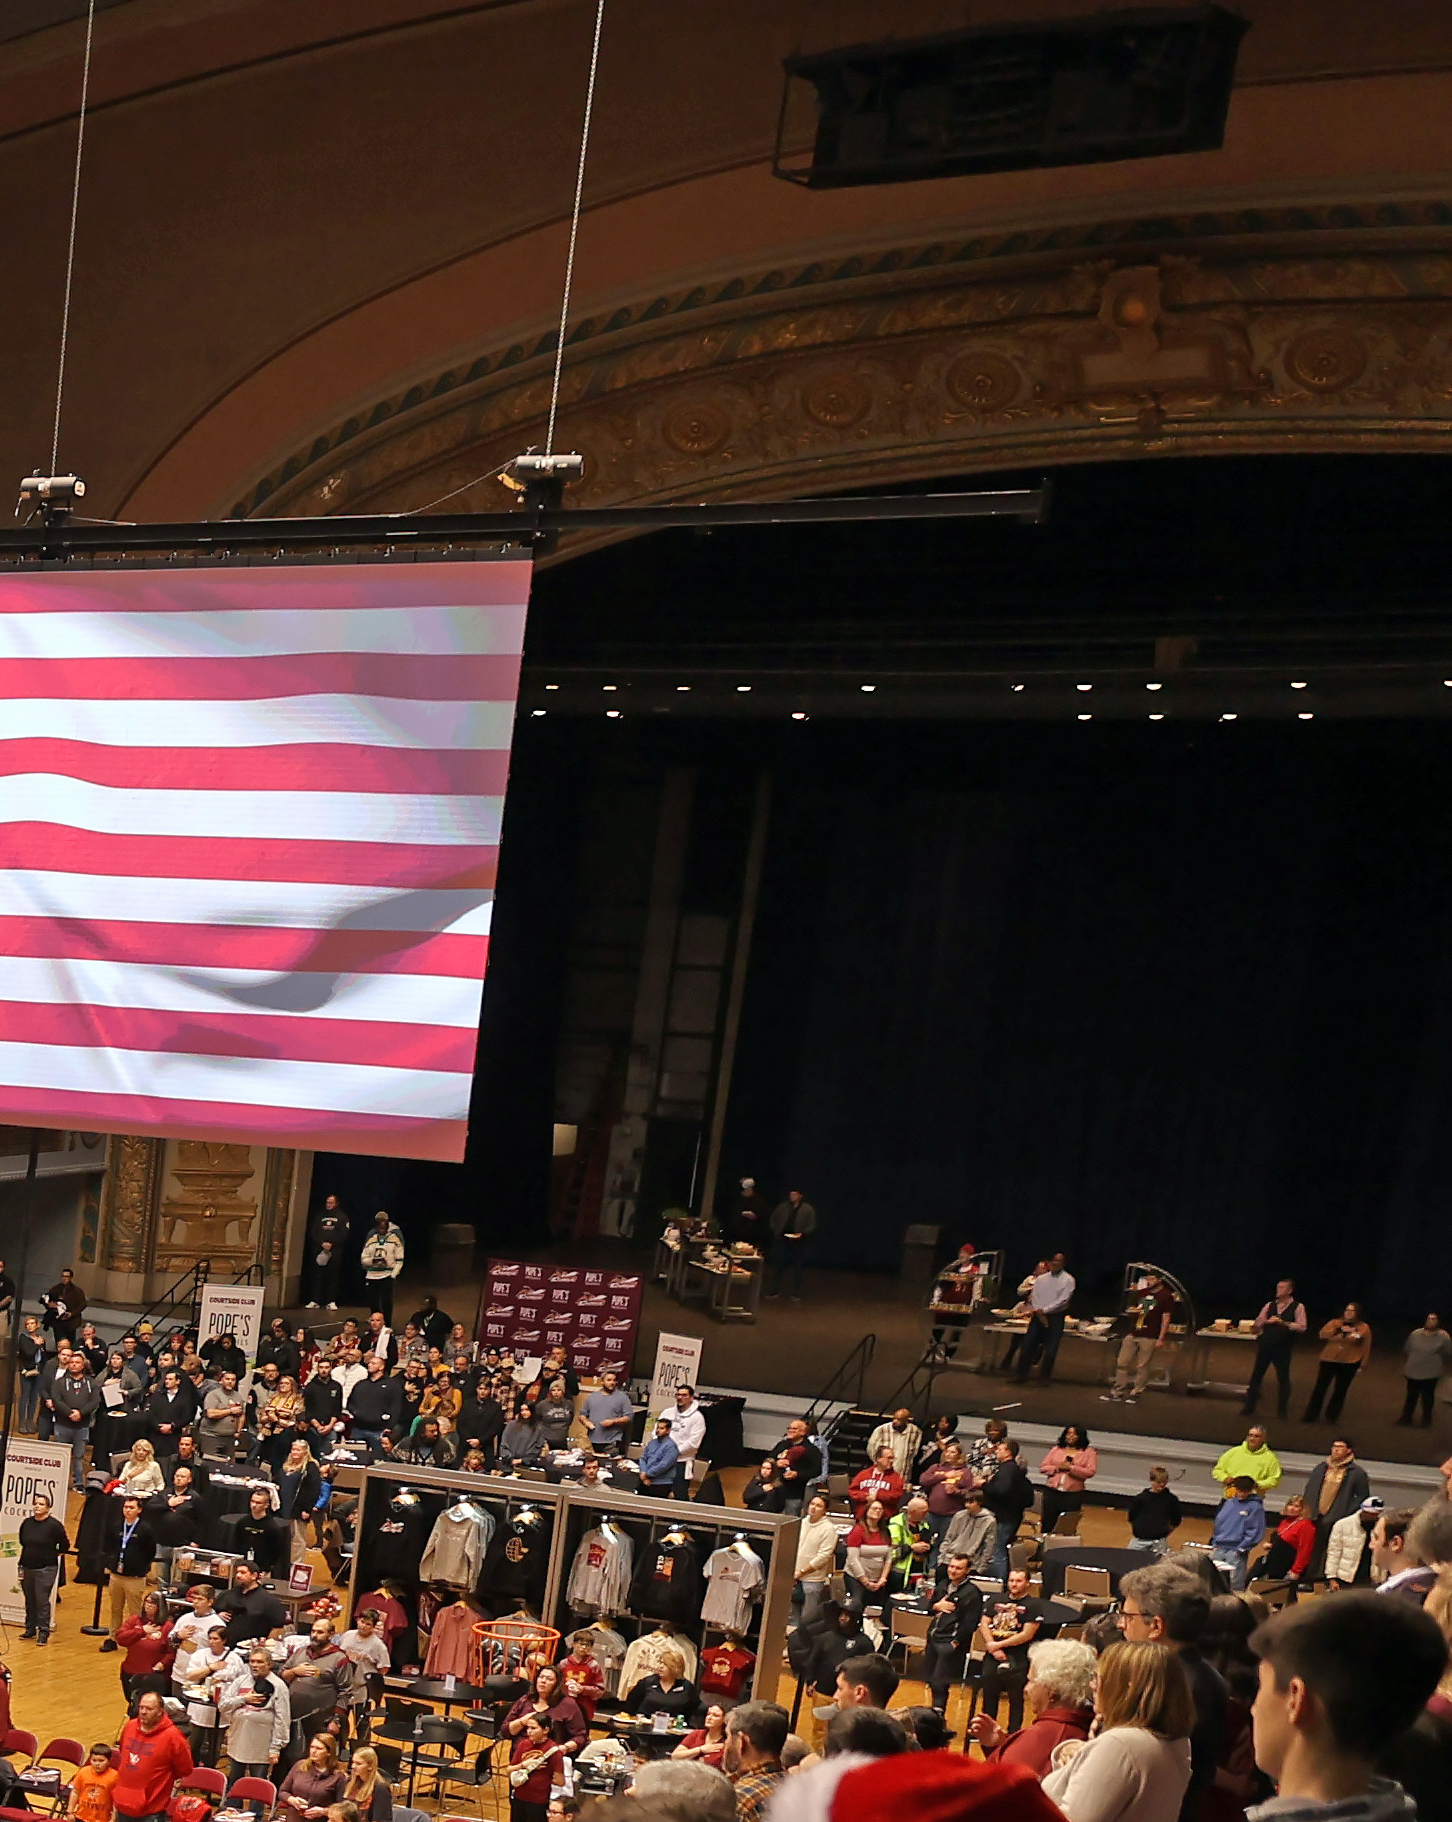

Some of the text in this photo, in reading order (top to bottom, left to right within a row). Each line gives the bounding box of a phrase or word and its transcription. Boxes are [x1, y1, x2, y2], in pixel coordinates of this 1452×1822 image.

[210, 1297, 240, 1305] COURTSIDE
[209, 1312, 251, 1337] POPE'S
[6, 1454, 61, 1468] COURTSIDE CLUB
[860, 1479, 891, 1490] INDIANA
[4, 1506, 34, 1517] COCKT
